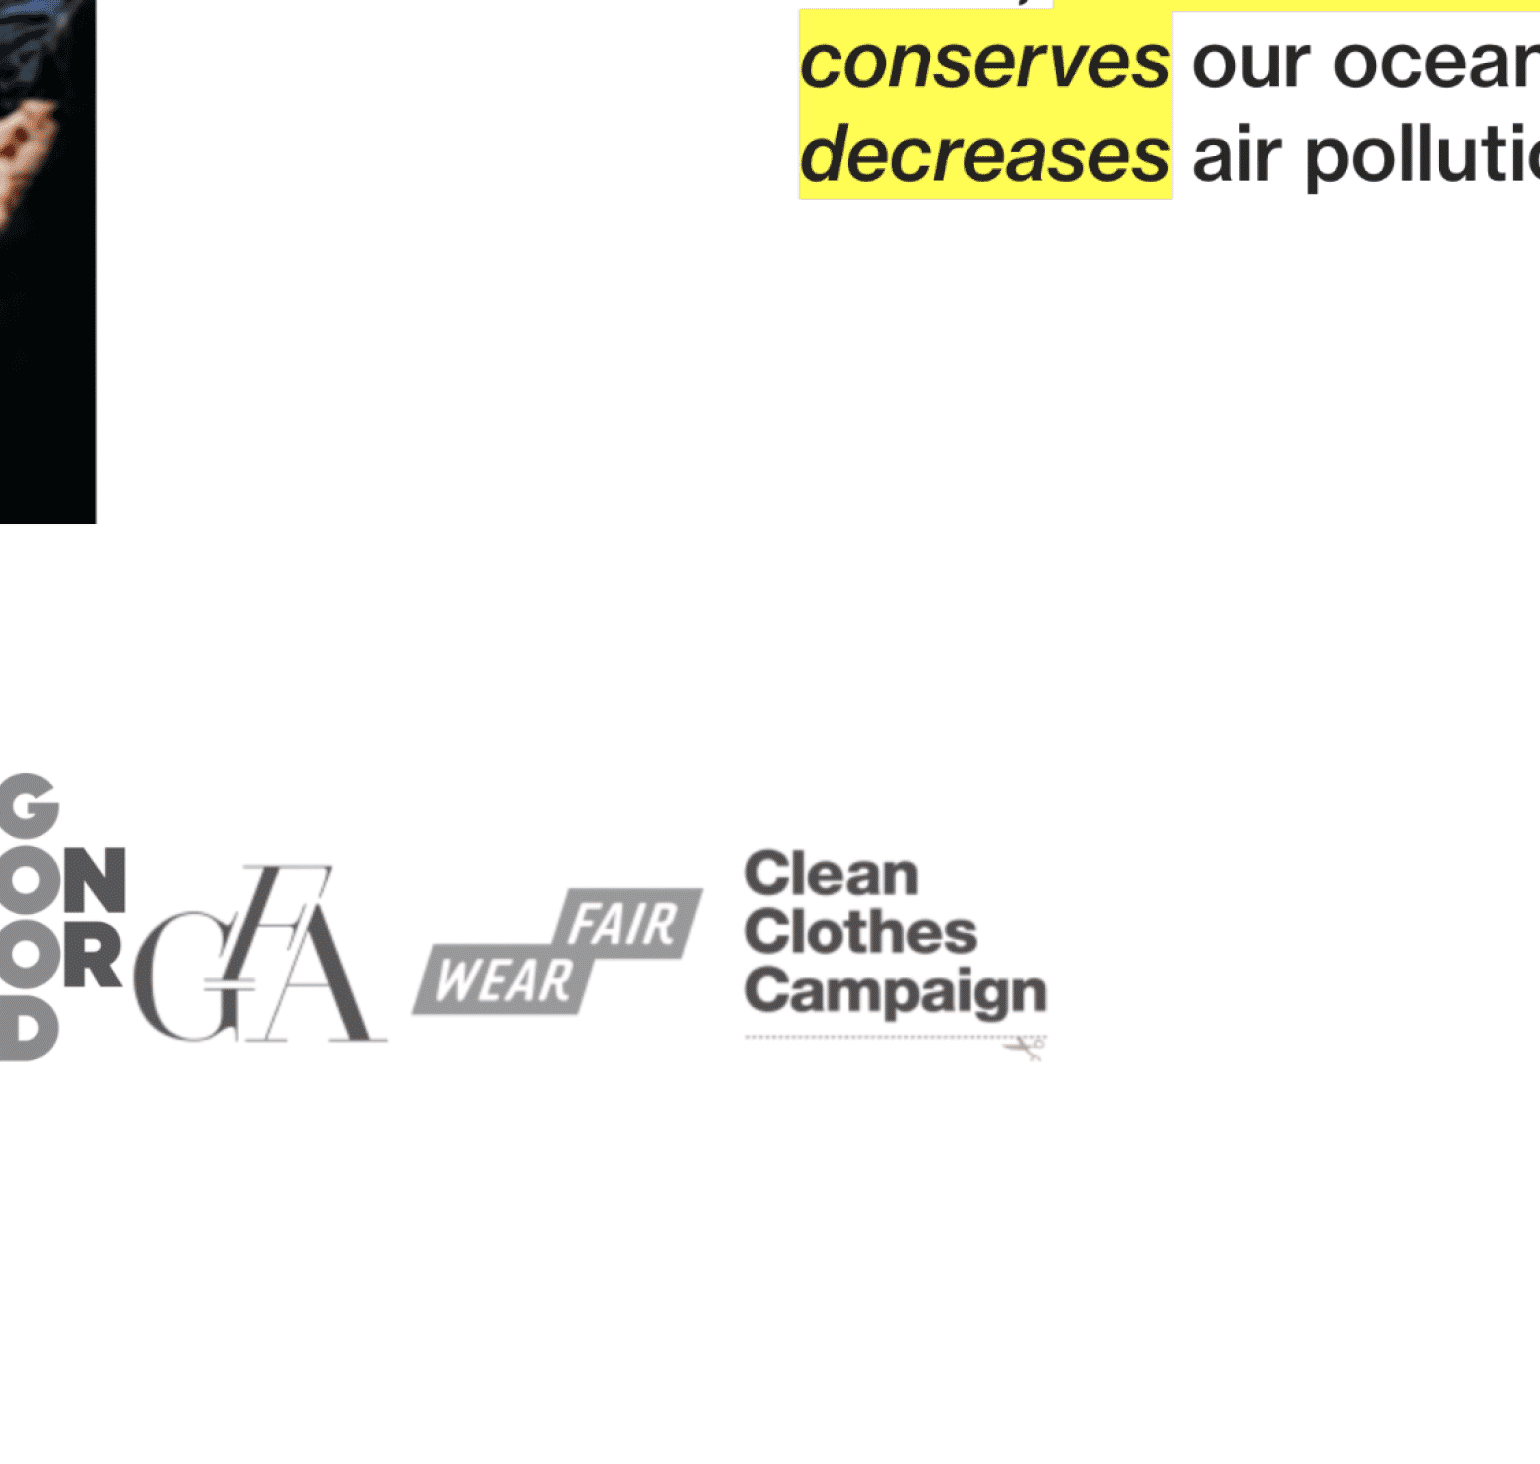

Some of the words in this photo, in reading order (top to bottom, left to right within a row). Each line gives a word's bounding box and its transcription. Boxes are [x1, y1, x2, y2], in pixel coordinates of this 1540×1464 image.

[800, 43, 1171, 89] conserves
[1193, 44, 1312, 89] our
[800, 122, 1171, 183] decreases
[1193, 122, 1283, 183] air
[744, 848, 918, 896] Clean
[566, 901, 679, 946] FAIR
[744, 906, 978, 955] Clothes
[435, 958, 574, 1002] WEAR
[744, 965, 1047, 1023] Campaign
